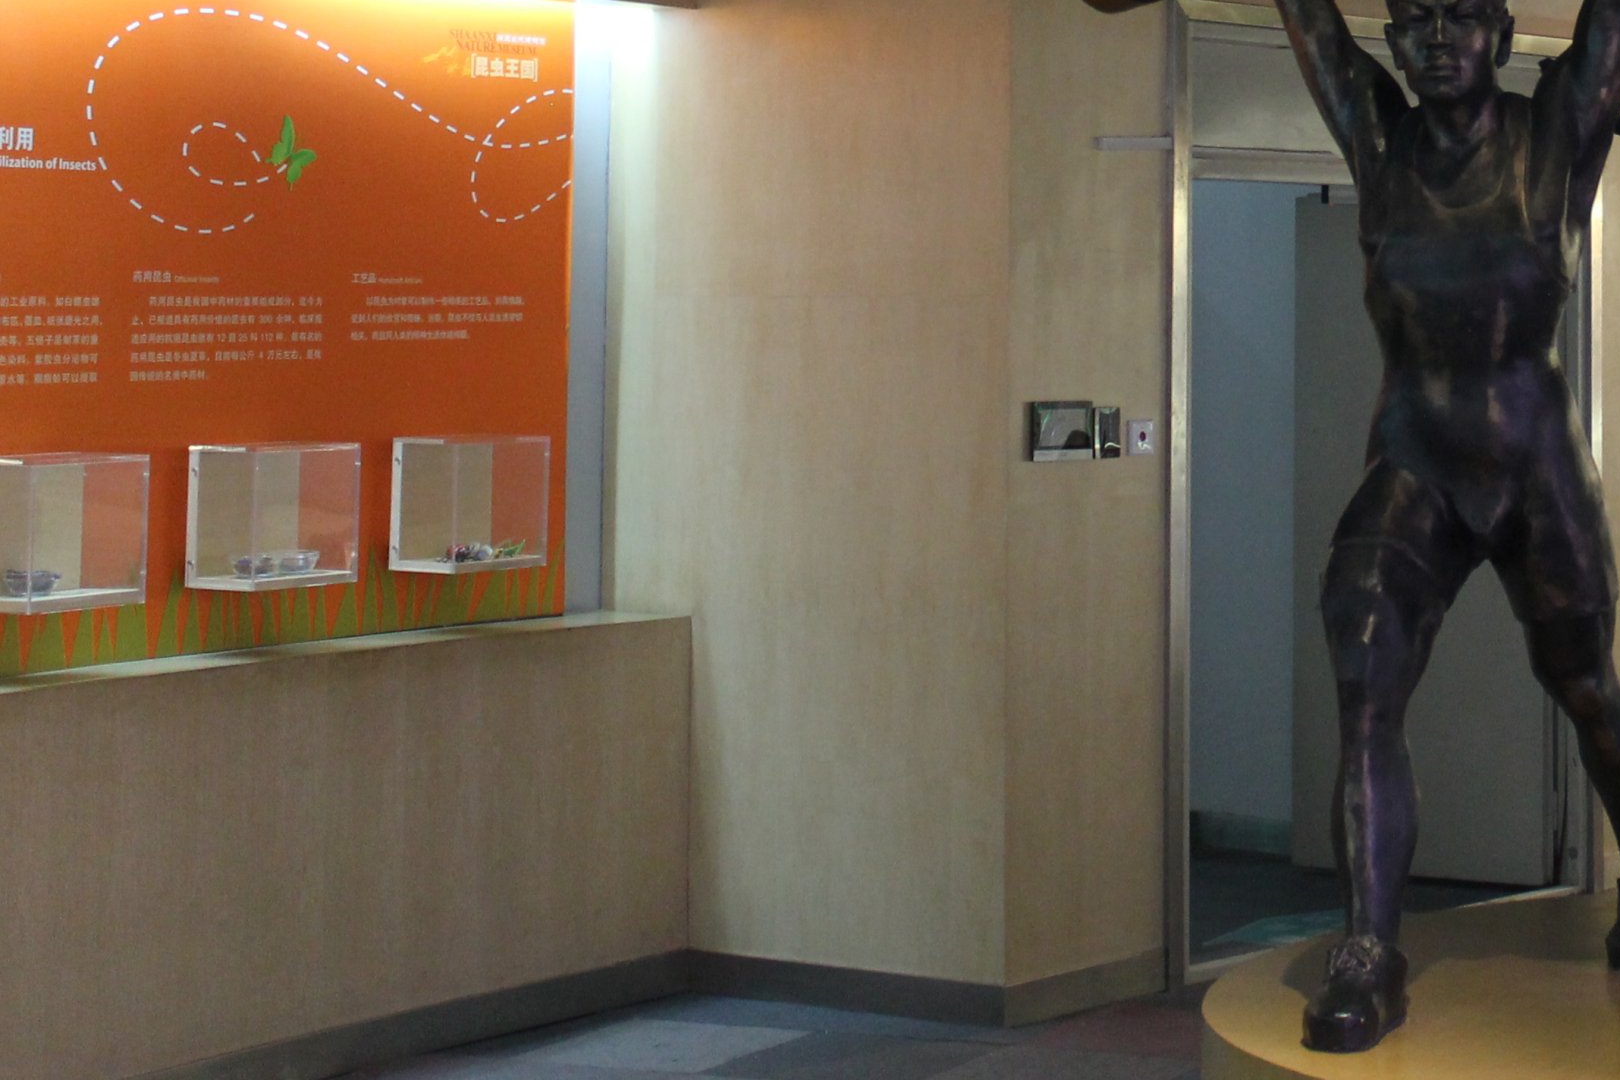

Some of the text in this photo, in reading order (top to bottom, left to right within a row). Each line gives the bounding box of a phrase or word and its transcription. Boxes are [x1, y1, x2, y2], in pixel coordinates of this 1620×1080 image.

[45, 157, 57, 169] of
[59, 158, 97, 171] Insects
[352, 273, 376, 283] 工艺品
